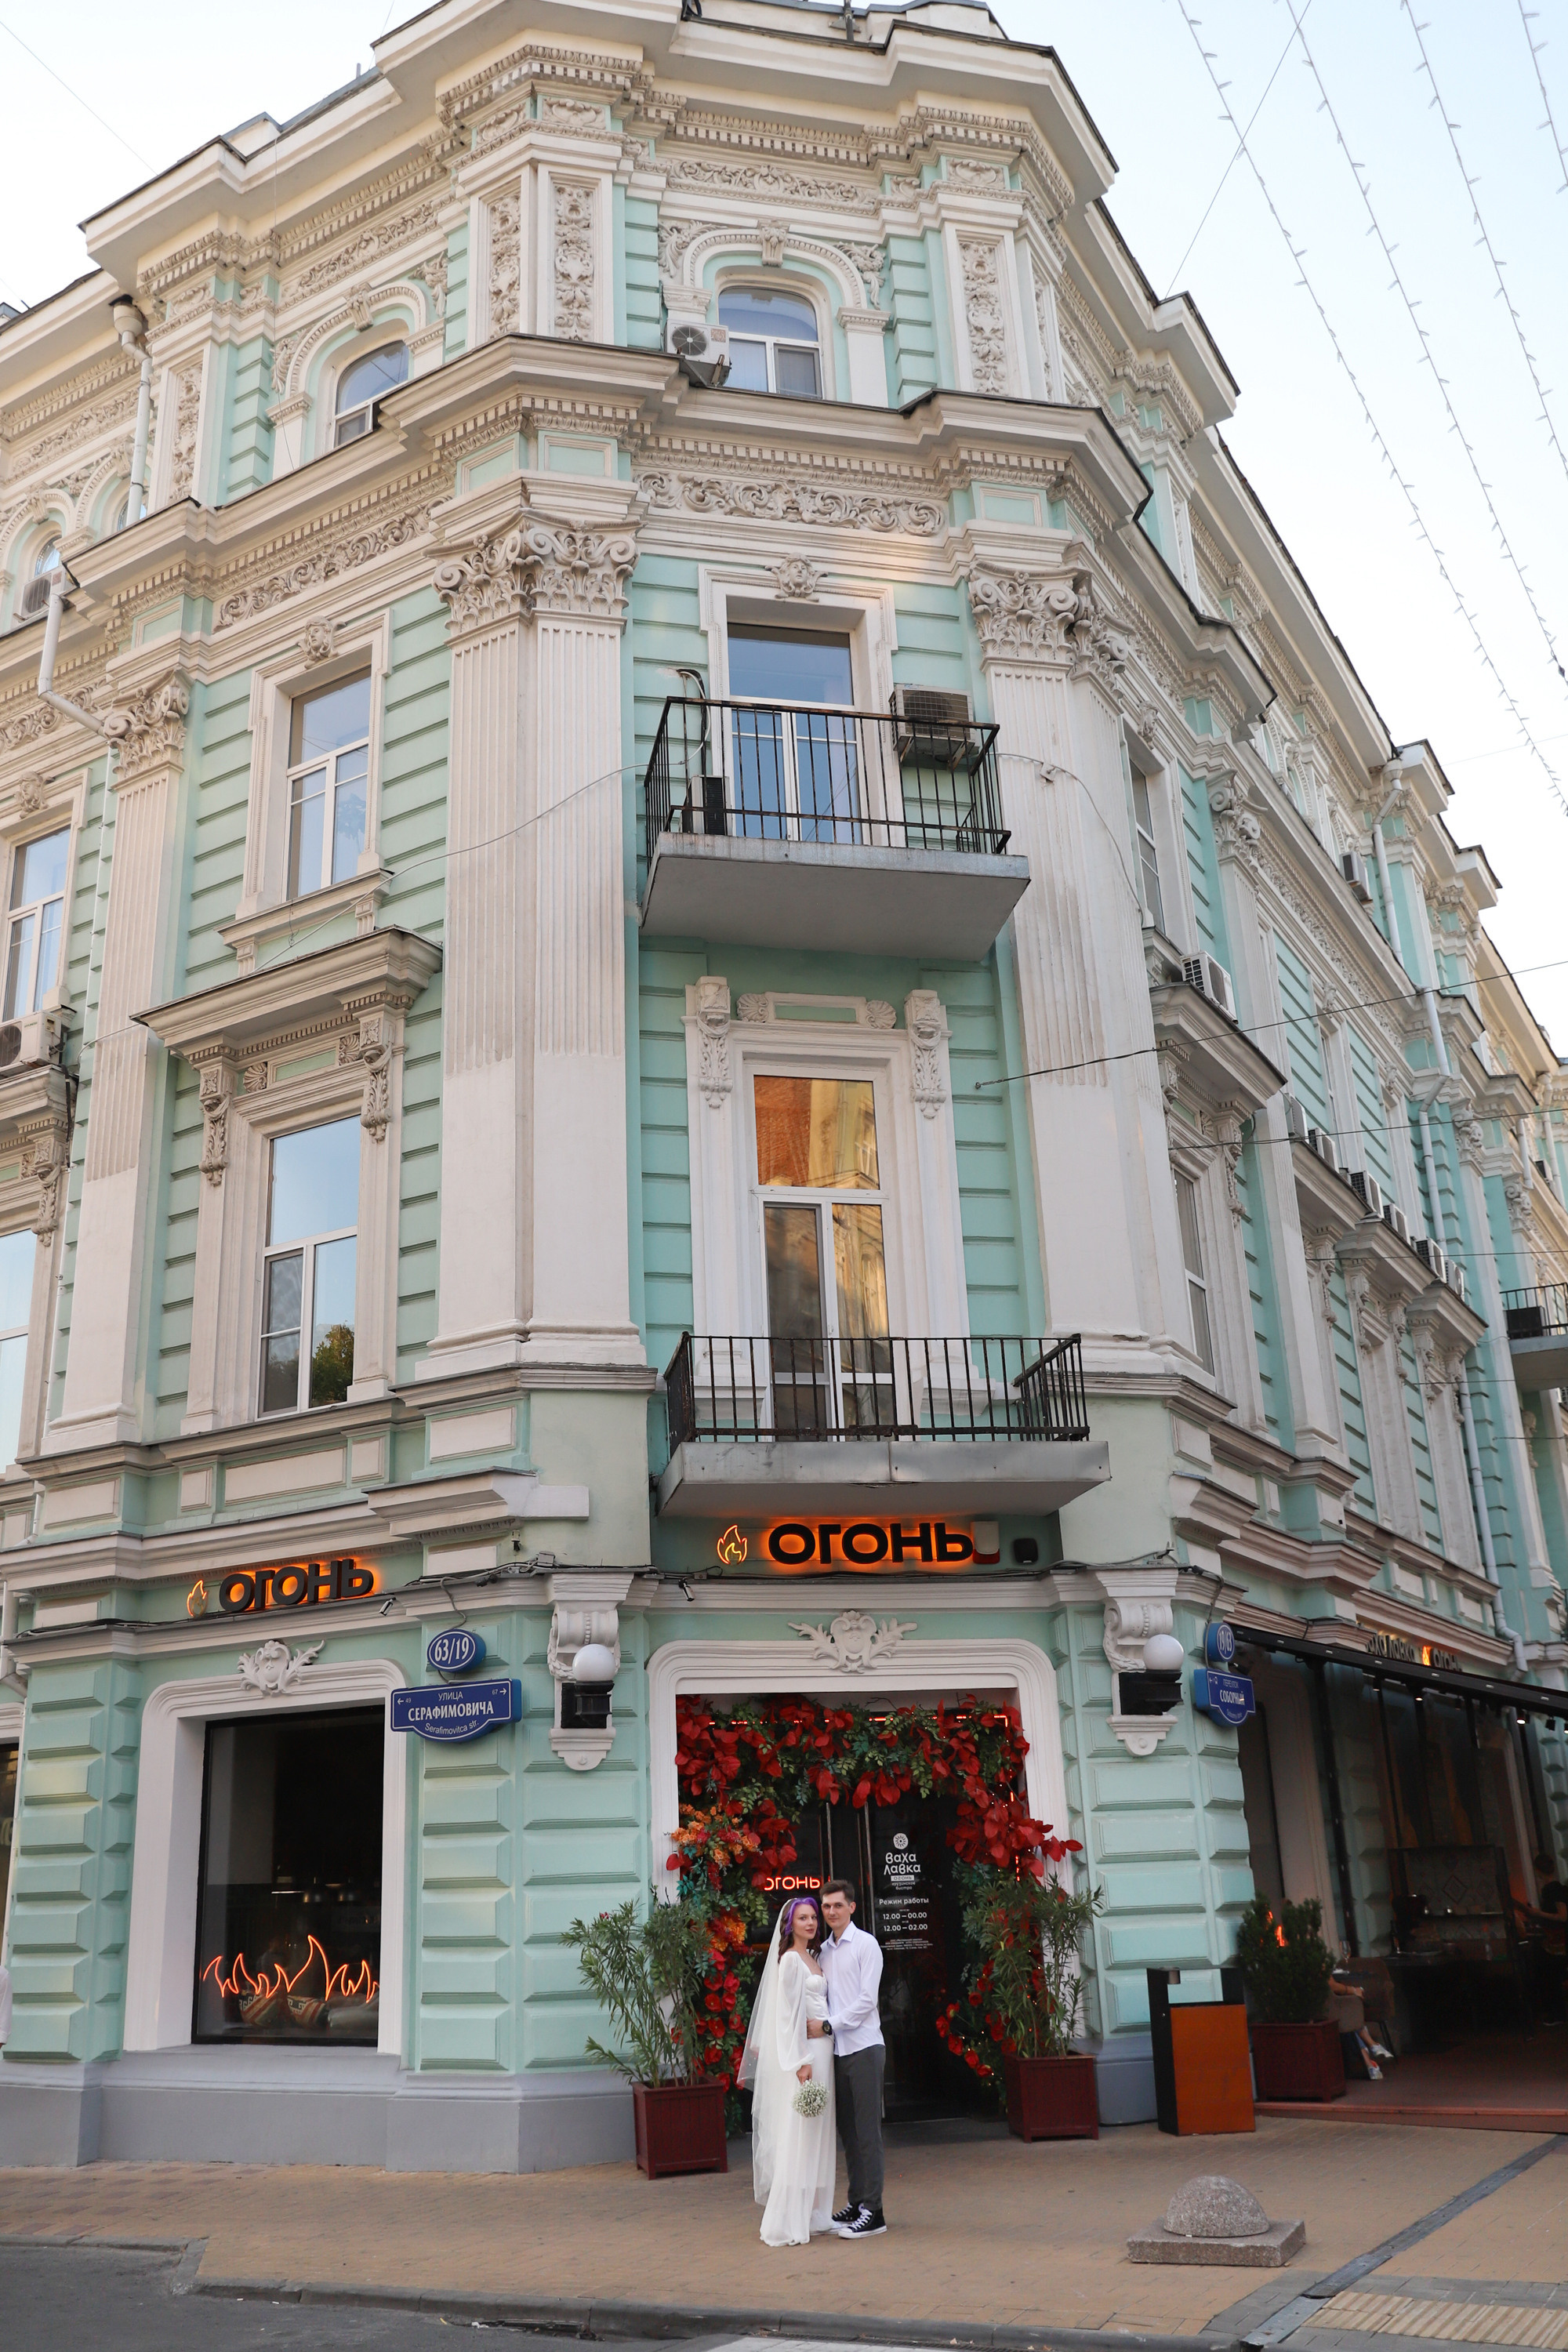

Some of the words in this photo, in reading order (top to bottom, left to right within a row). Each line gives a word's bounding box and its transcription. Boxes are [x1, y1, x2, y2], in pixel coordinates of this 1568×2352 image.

[768, 1523, 973, 1564] ОГОНЬ
[220, 1559, 374, 1612] ОГОНЬ
[434, 1637, 469, 1664] 63/19
[1219, 1631, 1232, 1654] 19/63
[438, 1691, 463, 1701] УЛИЦА
[408, 1700, 494, 1722] СЕРАФИМОВИЧА
[424, 1722, 468, 1735] Serafimovitca
[469, 1720, 479, 1730] str.
